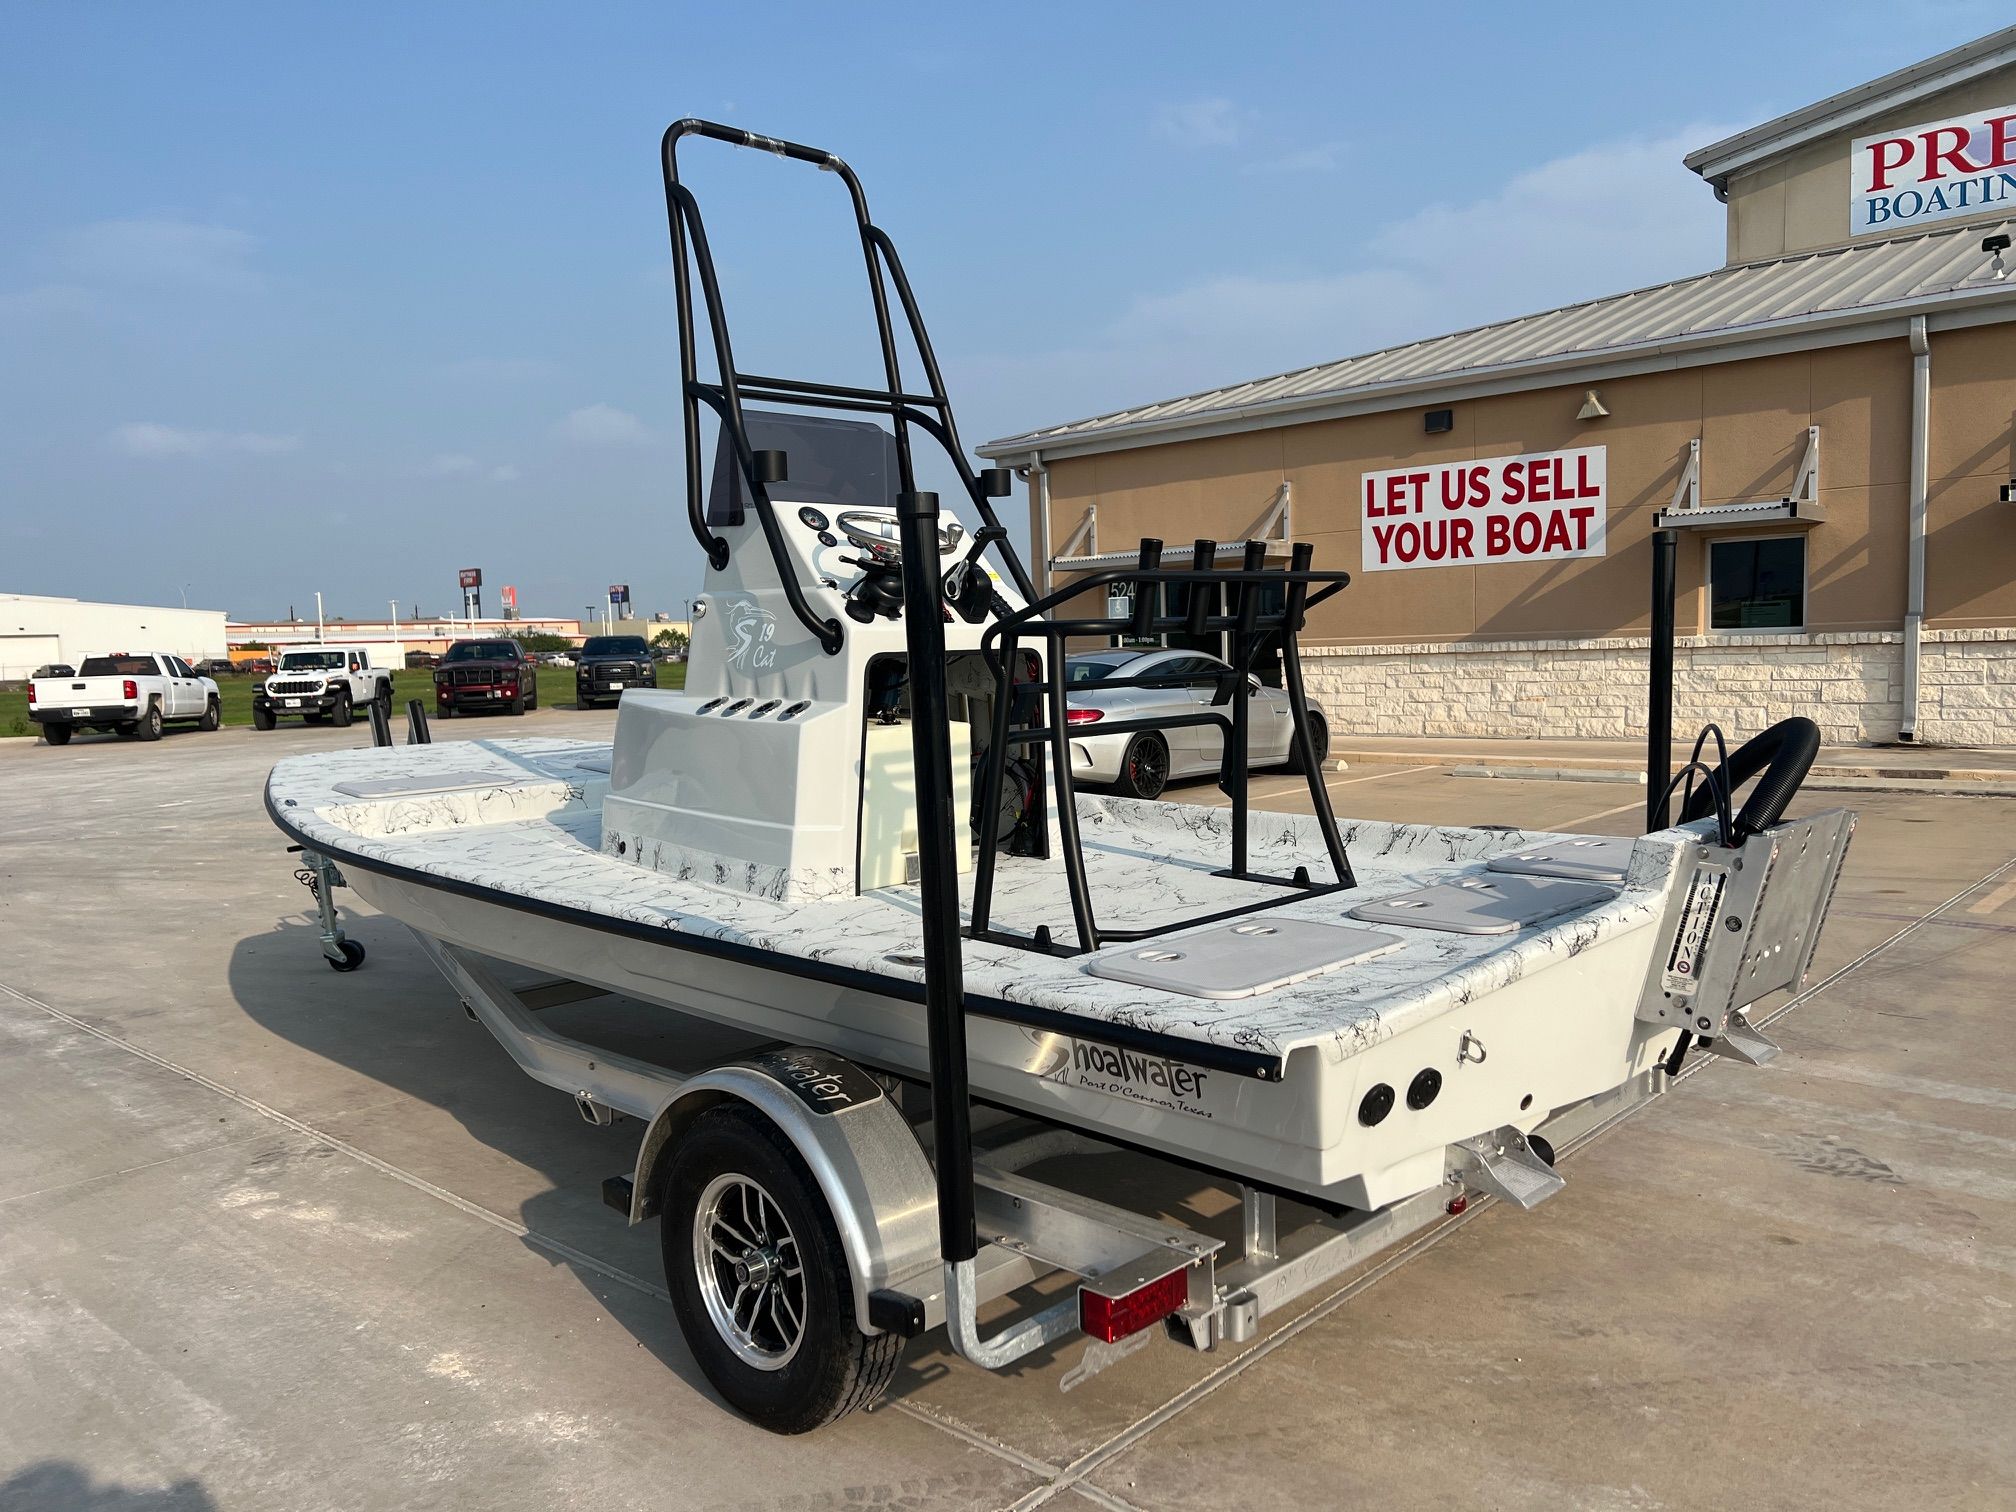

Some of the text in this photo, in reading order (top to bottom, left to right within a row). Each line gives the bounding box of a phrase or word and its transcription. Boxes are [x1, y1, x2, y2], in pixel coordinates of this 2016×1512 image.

[1367, 455, 1600, 518] LET US SELL
[1372, 507, 1595, 564] YOUR BOAT
[759, 623, 775, 642] 19
[753, 645, 777, 668] Cat
[1079, 1074, 1106, 1091] Port
[1176, 1100, 1214, 1119] Texas
